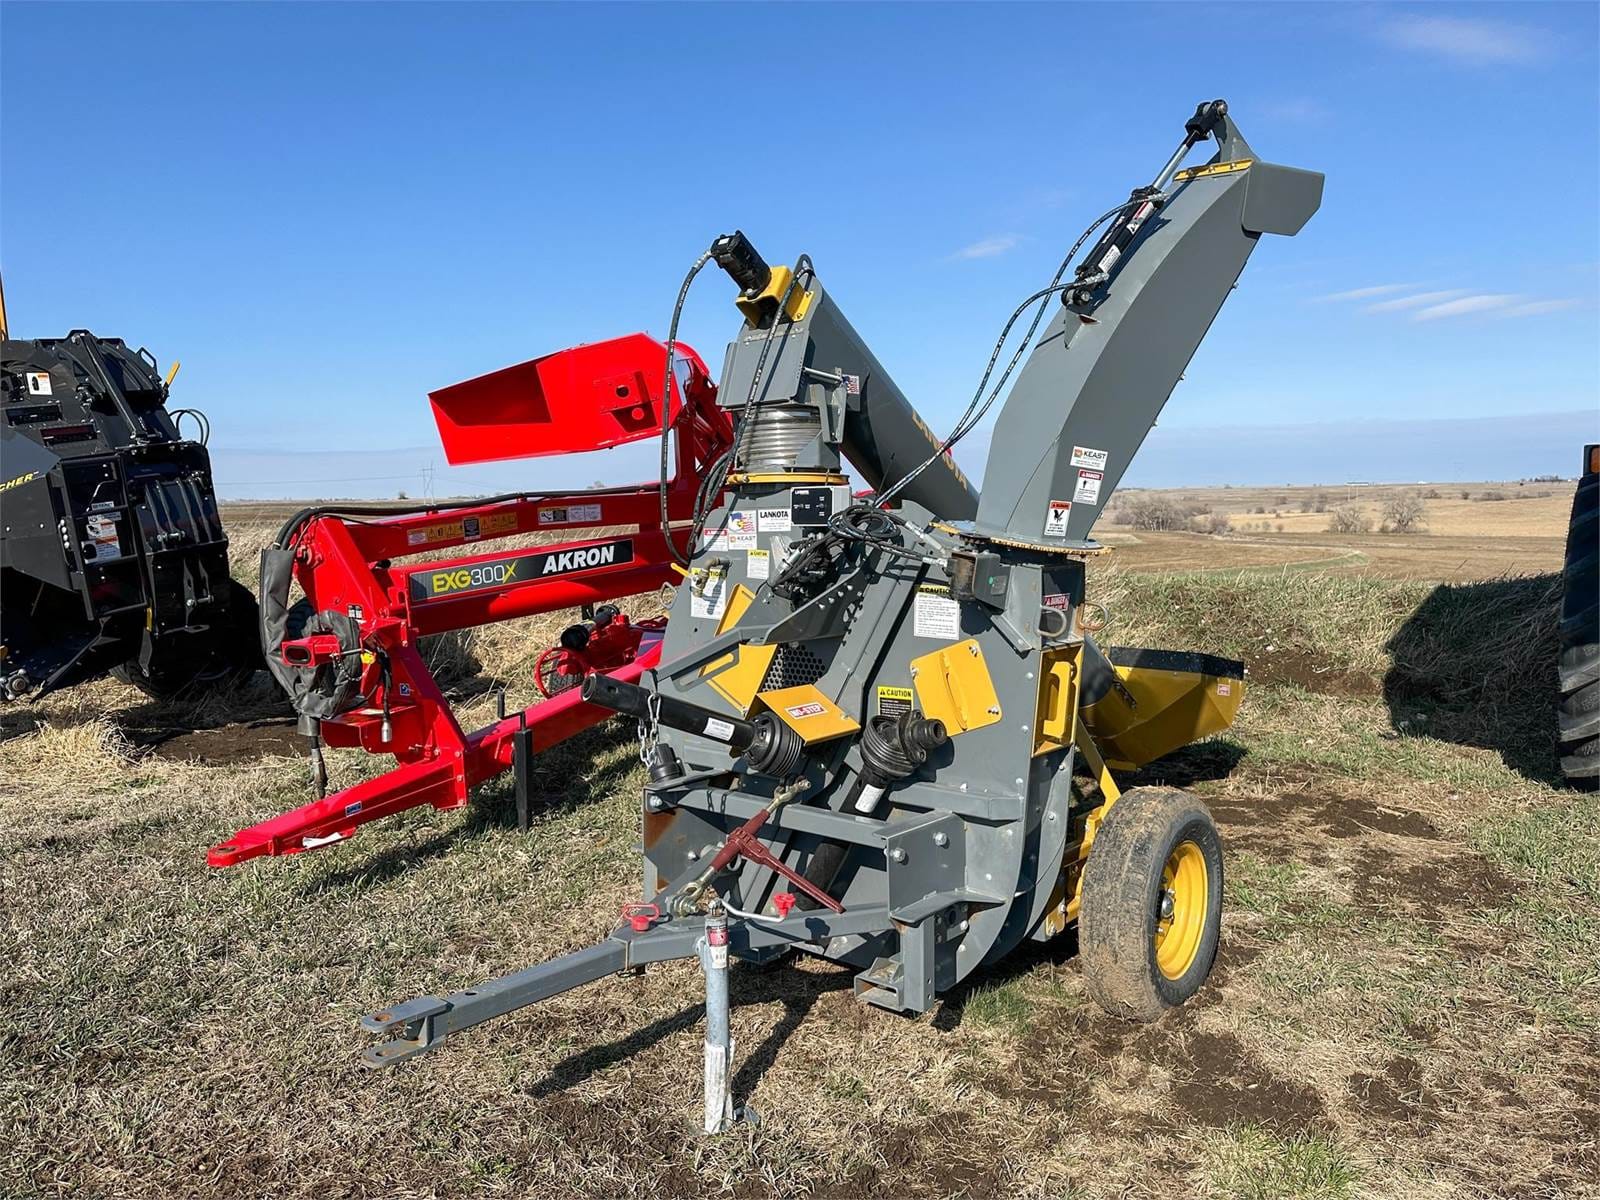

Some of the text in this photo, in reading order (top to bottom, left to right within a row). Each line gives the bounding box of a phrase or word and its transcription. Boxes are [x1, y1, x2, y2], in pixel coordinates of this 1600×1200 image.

[1083, 450, 1106, 460] KEAST
[432, 546, 615, 593] EXG300X AKRON
[886, 689, 912, 697] CAUTION
